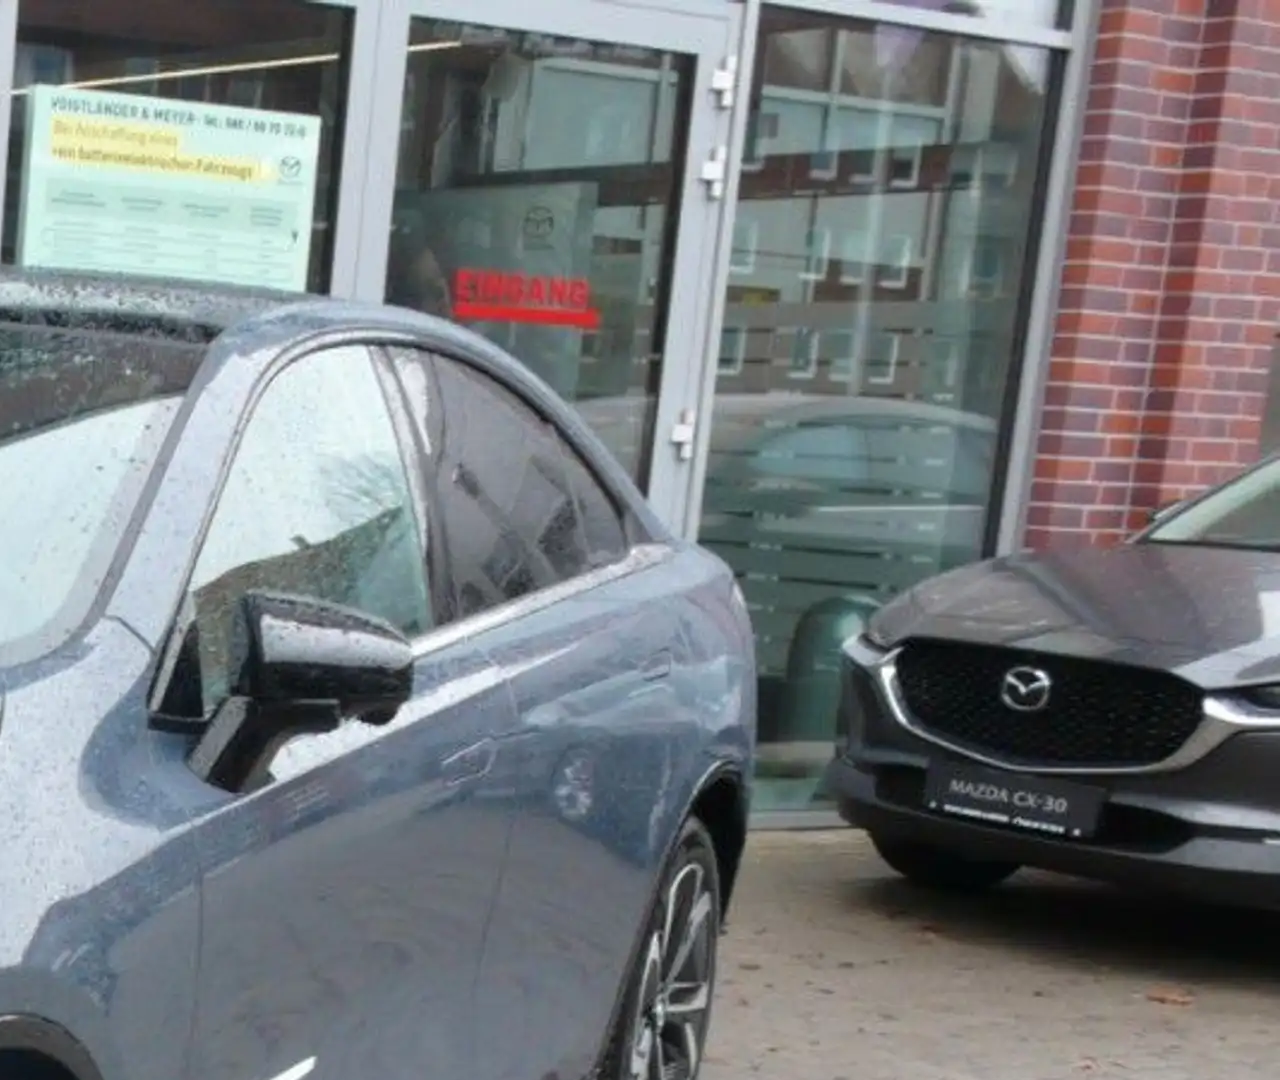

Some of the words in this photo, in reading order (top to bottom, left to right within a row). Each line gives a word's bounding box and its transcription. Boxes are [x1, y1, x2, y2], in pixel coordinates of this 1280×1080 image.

[456, 268, 590, 308] EINGANG
[949, 779, 1009, 802] MAZDA
[1012, 791, 1068, 814] CX-30
